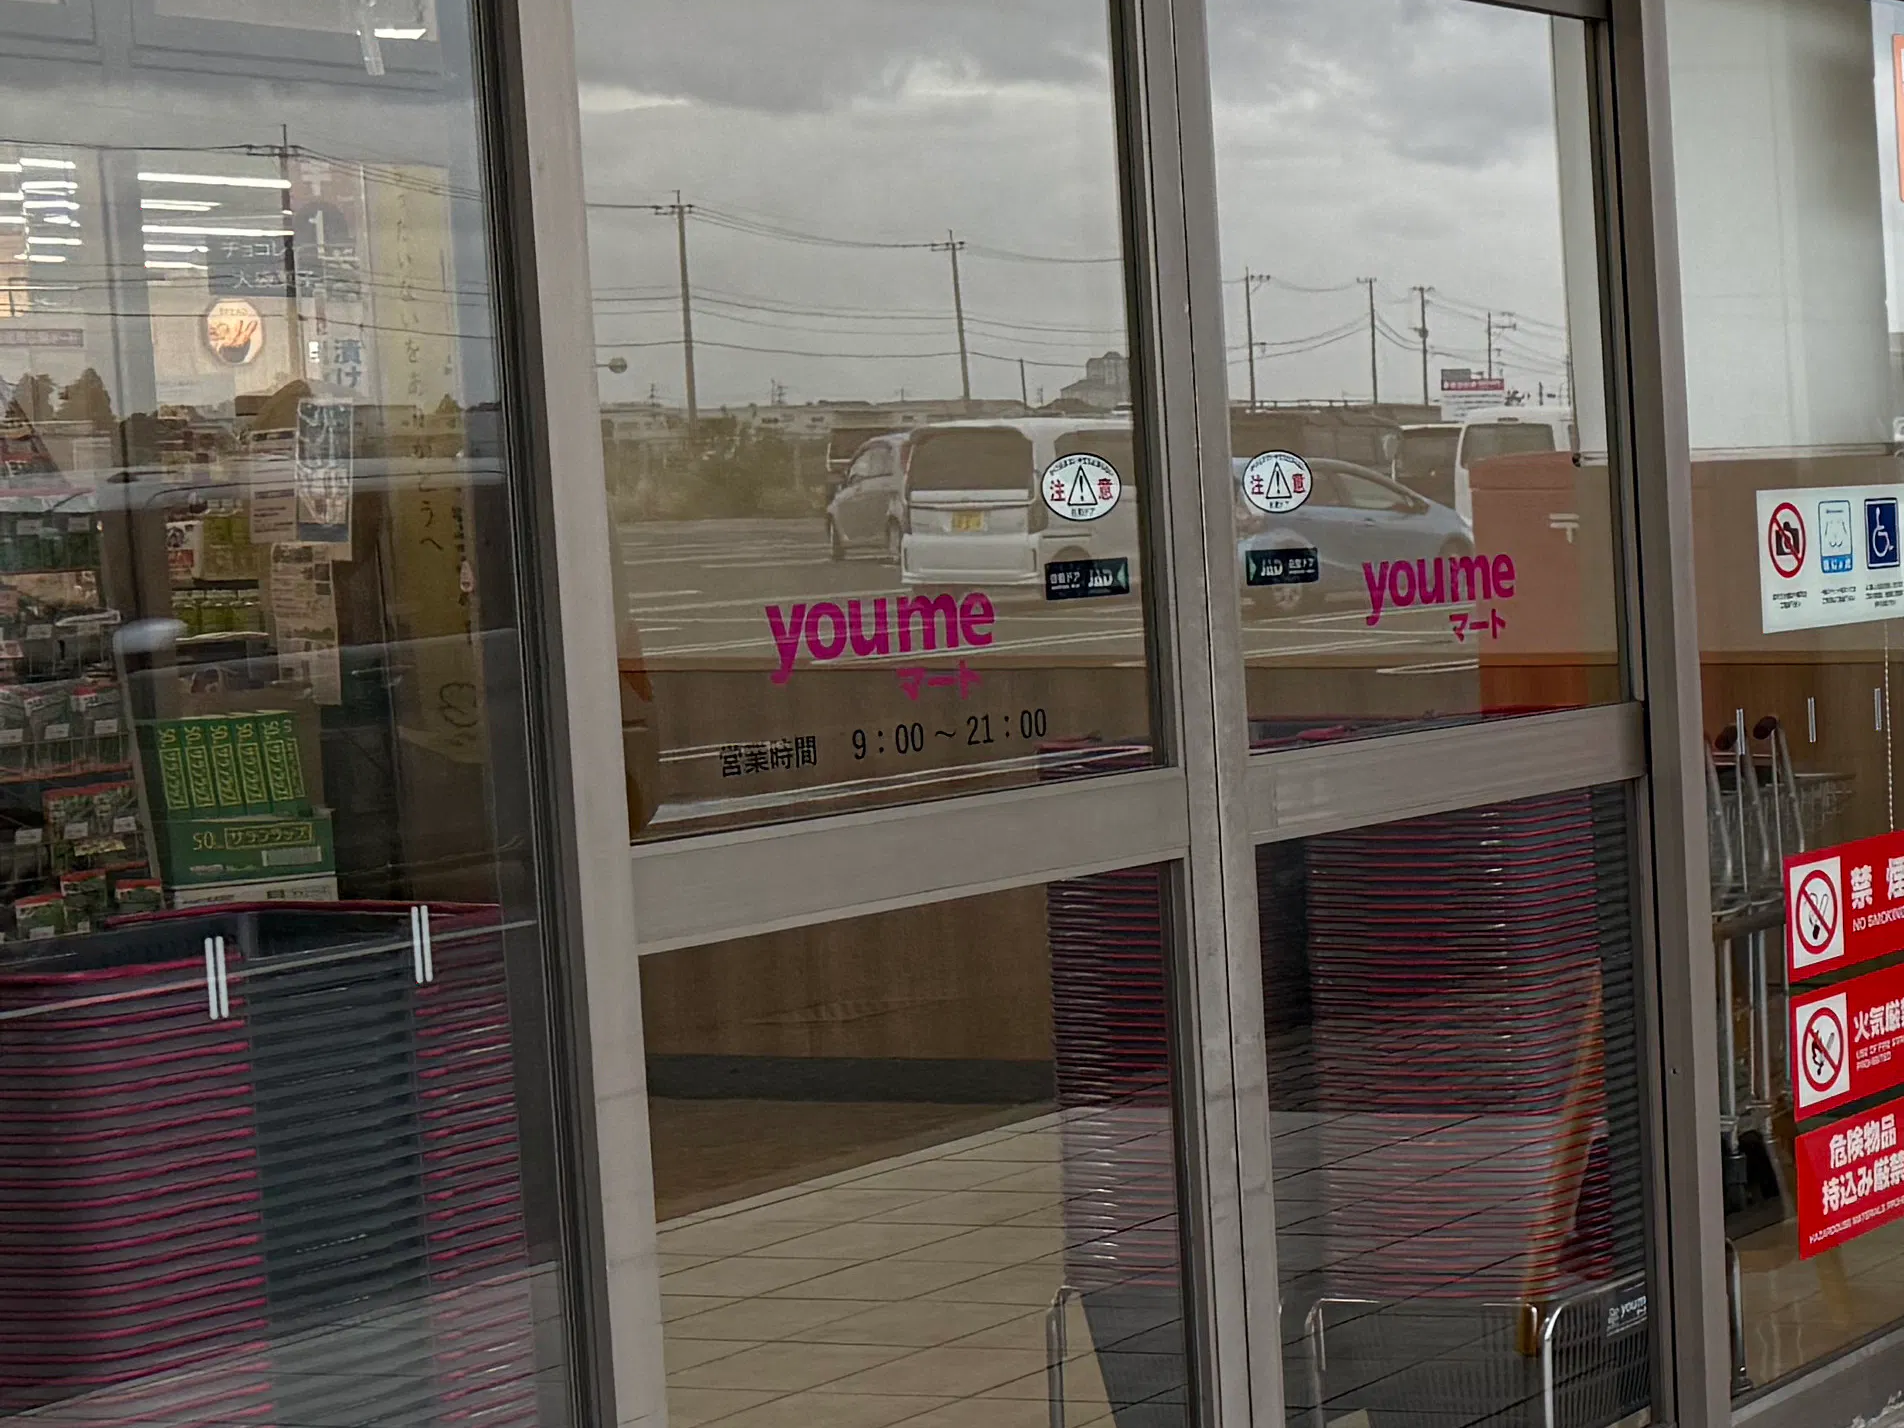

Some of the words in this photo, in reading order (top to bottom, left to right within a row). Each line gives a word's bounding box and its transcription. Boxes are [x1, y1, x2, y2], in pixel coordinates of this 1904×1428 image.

[1050, 479, 1066, 501] 注
[1362, 554, 1516, 627] youme
[765, 592, 995, 684] youme
[1449, 608, 1507, 642] マート
[896, 659, 982, 700] マート
[718, 735, 818, 779] 営業時間
[1853, 917, 1866, 932] NO
[1830, 1113, 1897, 1168] 危険物品
[1621, 1295, 1647, 1319] youm
